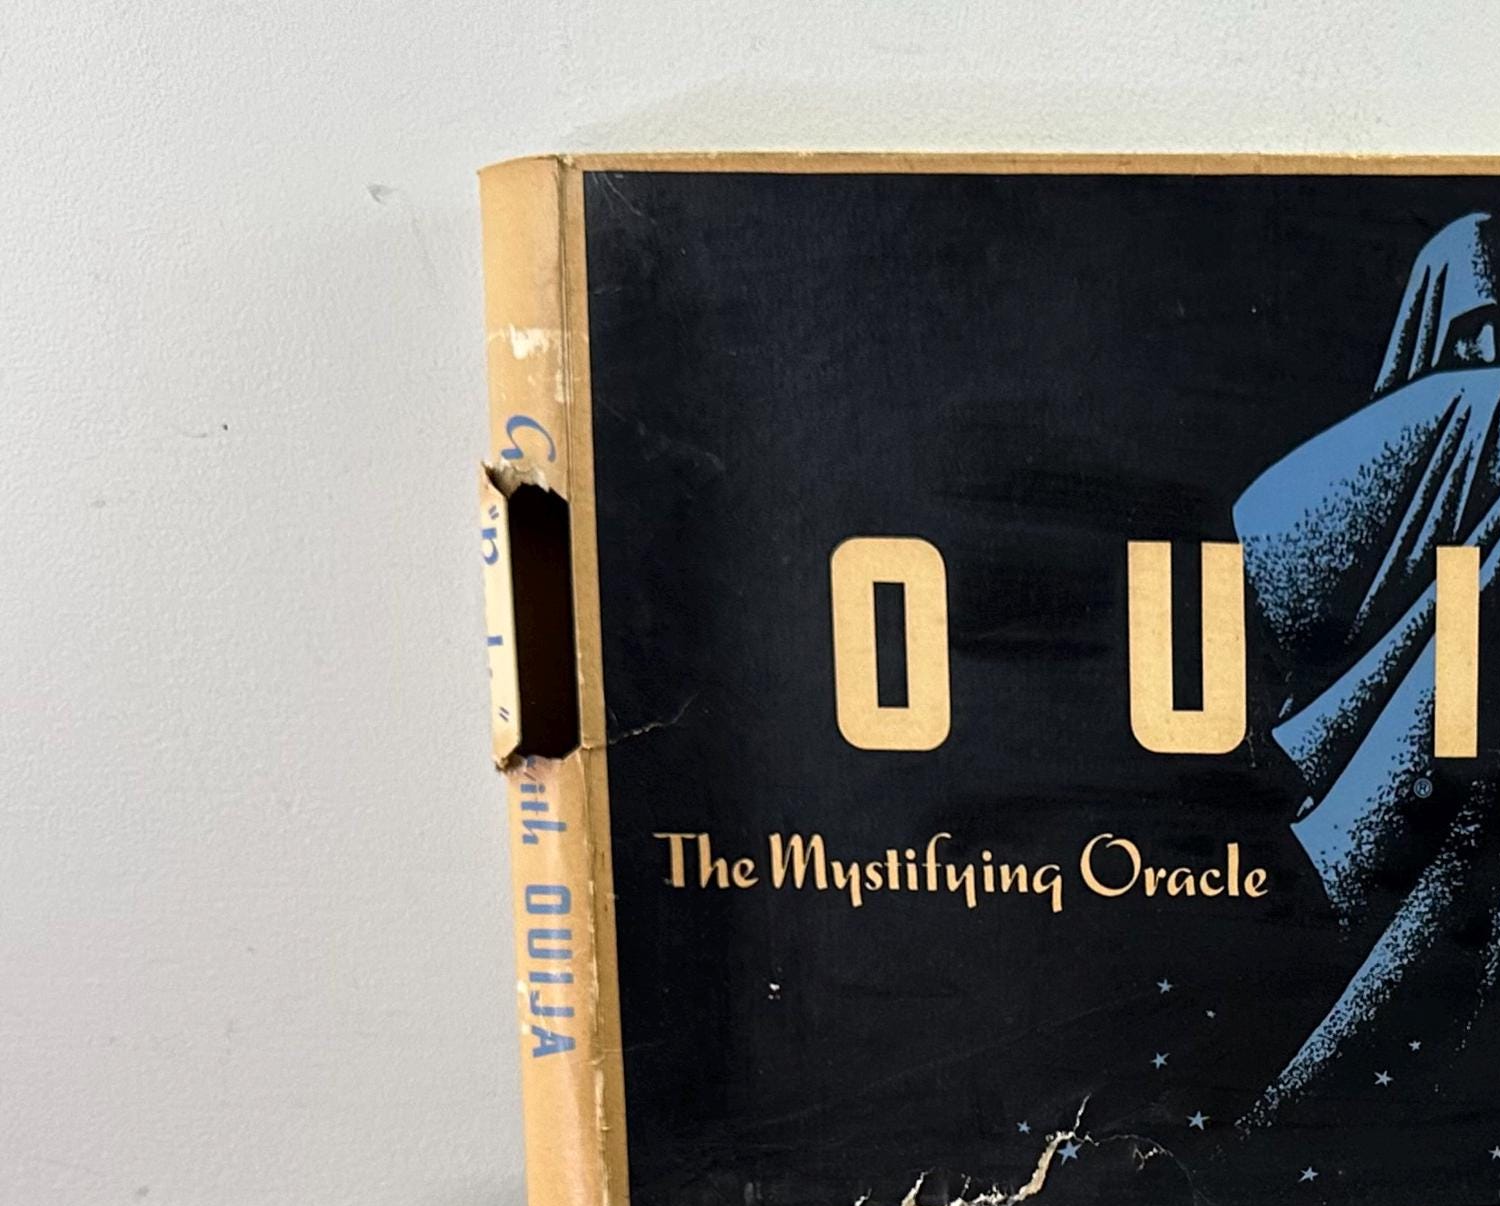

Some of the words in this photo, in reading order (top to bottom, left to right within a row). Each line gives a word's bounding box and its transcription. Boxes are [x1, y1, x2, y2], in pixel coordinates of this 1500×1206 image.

[653, 832, 759, 890] The
[769, 831, 1064, 914] Mystifying
[1079, 832, 1269, 899] Oracle
[524, 884, 577, 1059] OUIJA
